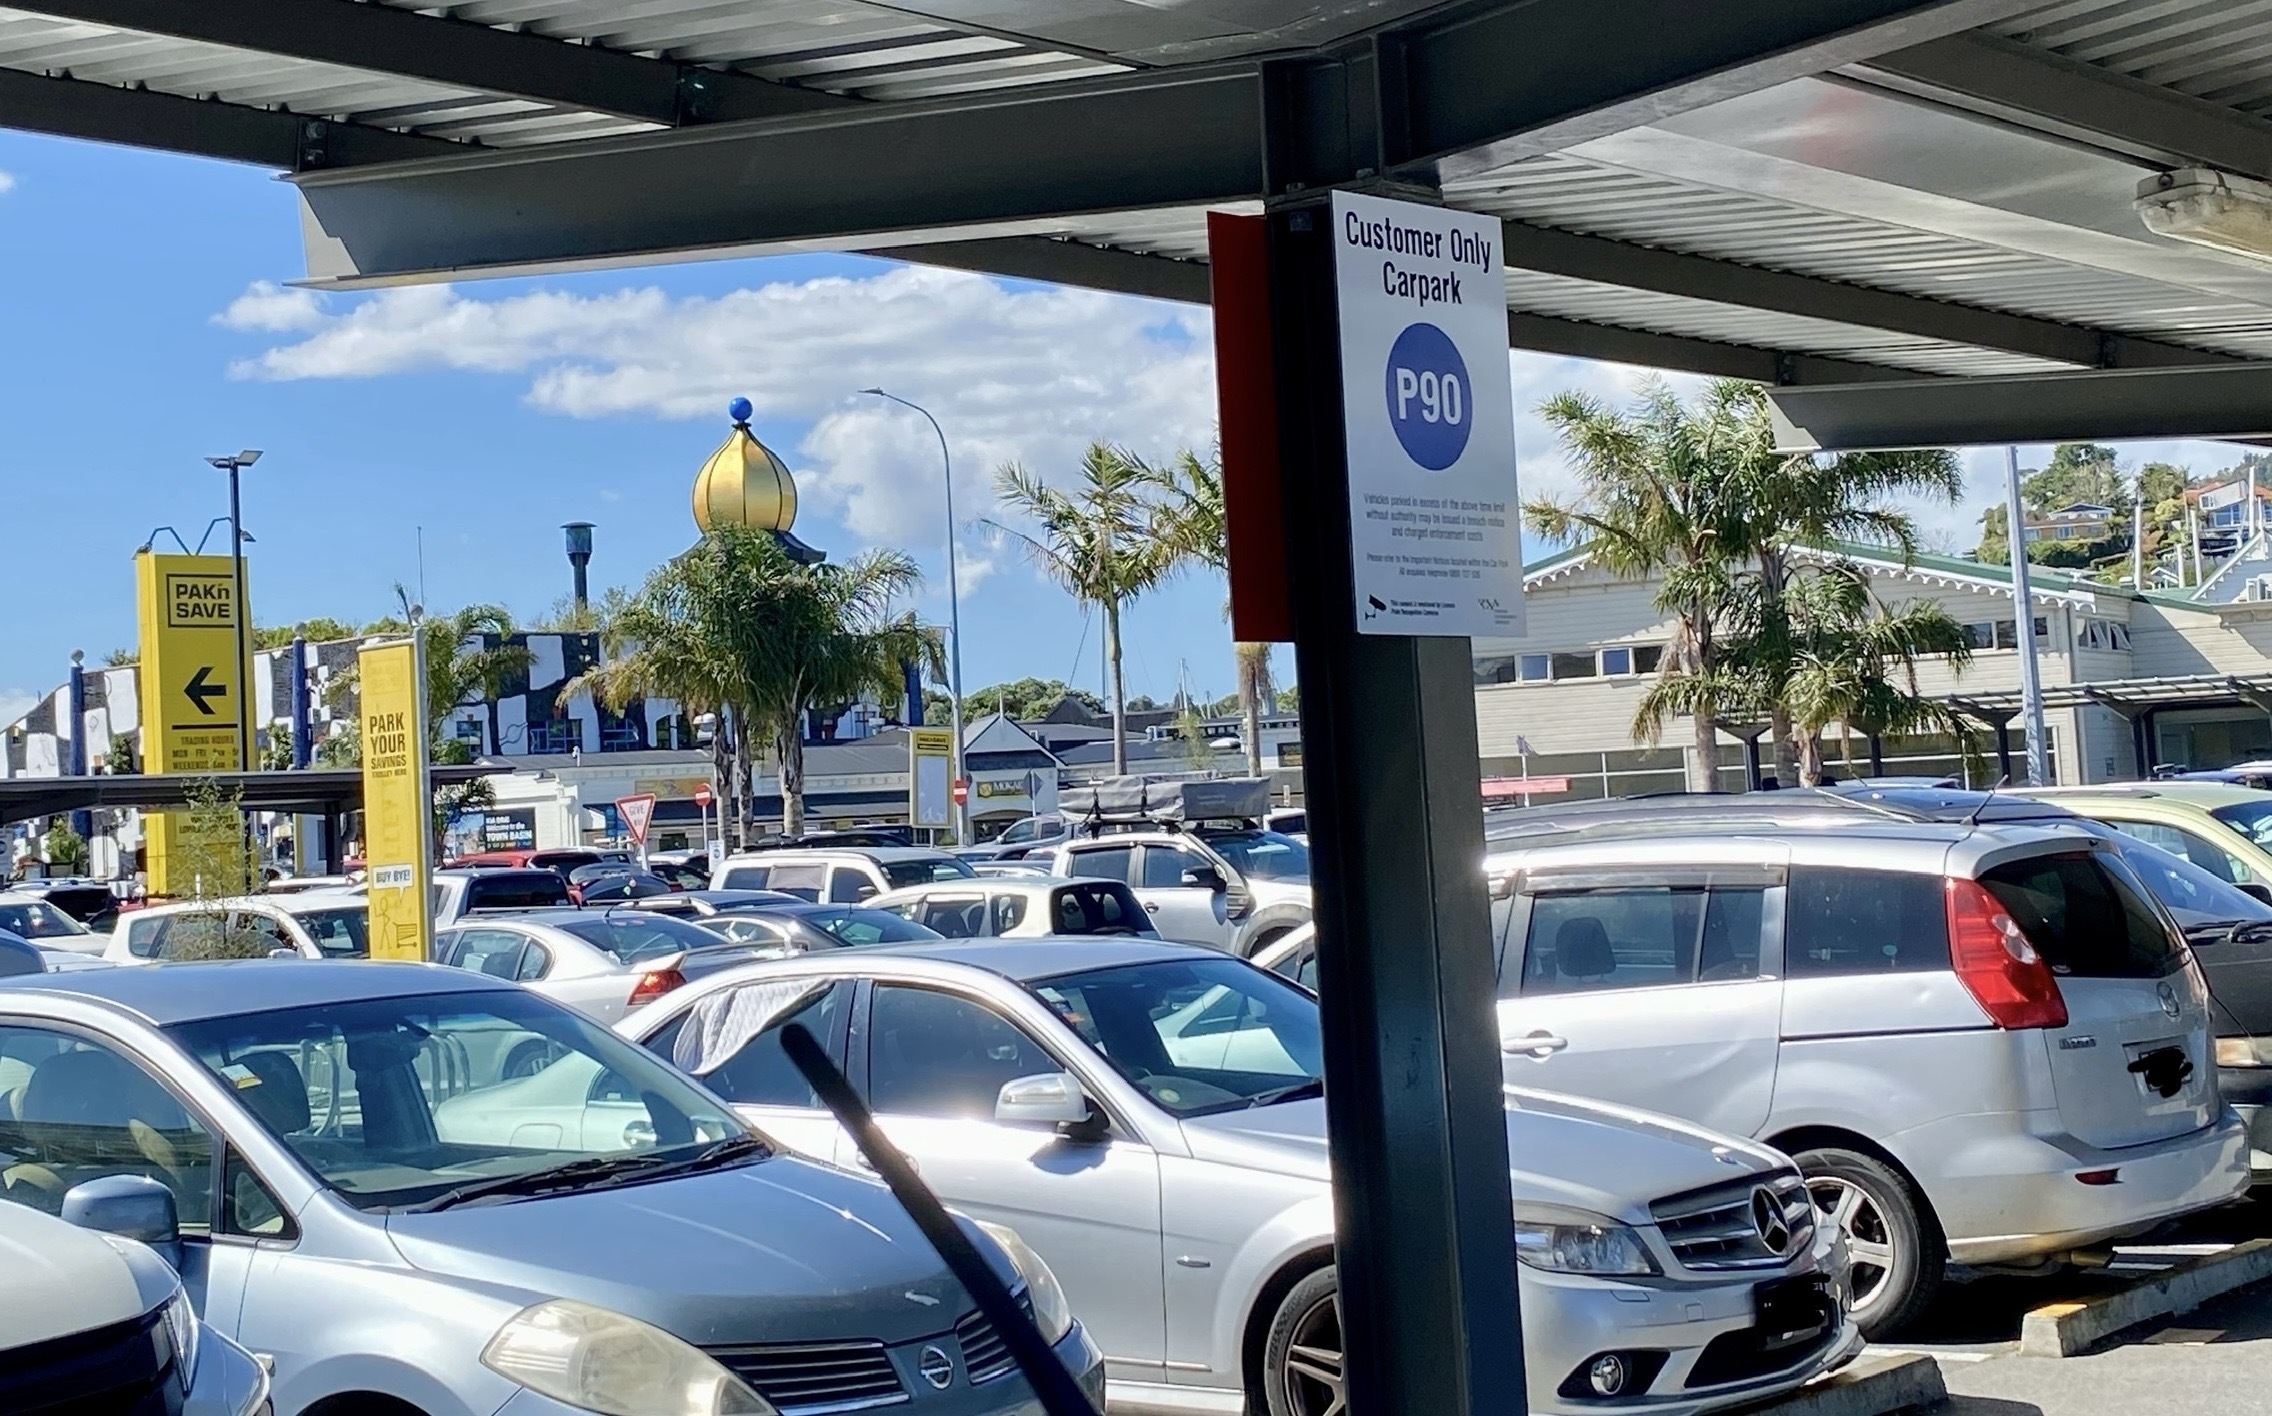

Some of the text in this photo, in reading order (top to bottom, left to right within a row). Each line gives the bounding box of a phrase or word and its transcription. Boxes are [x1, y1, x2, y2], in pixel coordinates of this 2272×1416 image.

[1345, 211, 1491, 274] Customer Only
[1383, 261, 1462, 307] Carpark
[1396, 367, 1462, 425] P90
[176, 603, 230, 618] SAVE
[369, 711, 405, 734] PARK
[370, 733, 406, 756] YOUR
[371, 754, 407, 770] SAVINGS
[629, 804, 645, 816] GIVE
[376, 870, 392, 884] BUY
